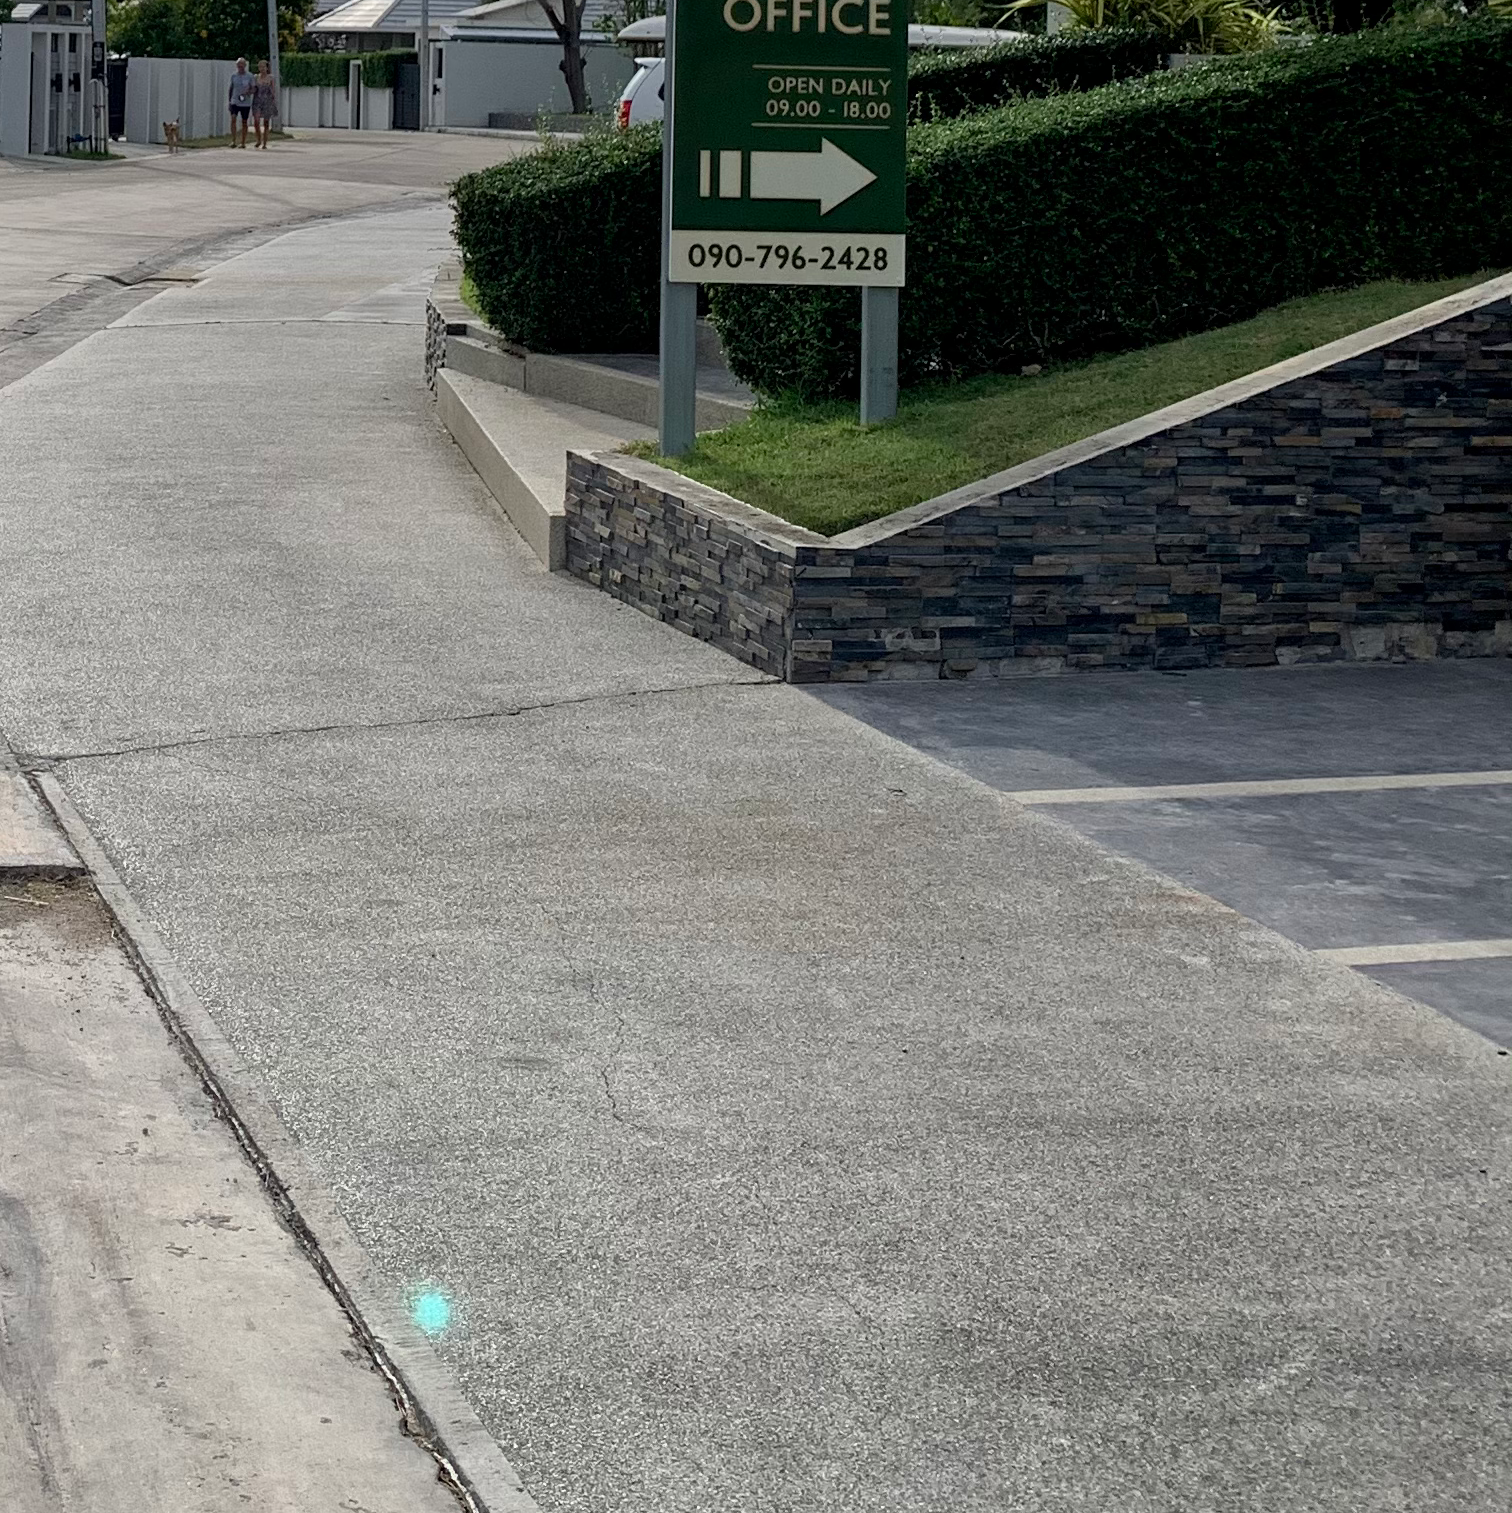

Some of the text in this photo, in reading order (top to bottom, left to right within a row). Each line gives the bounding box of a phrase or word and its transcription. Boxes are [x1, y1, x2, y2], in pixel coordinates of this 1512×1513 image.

[768, 76, 892, 98] OPEN DAILY
[765, 99, 821, 119] 09.00
[843, 101, 892, 120] 18.00
[687, 242, 890, 272] 090-796-2428
